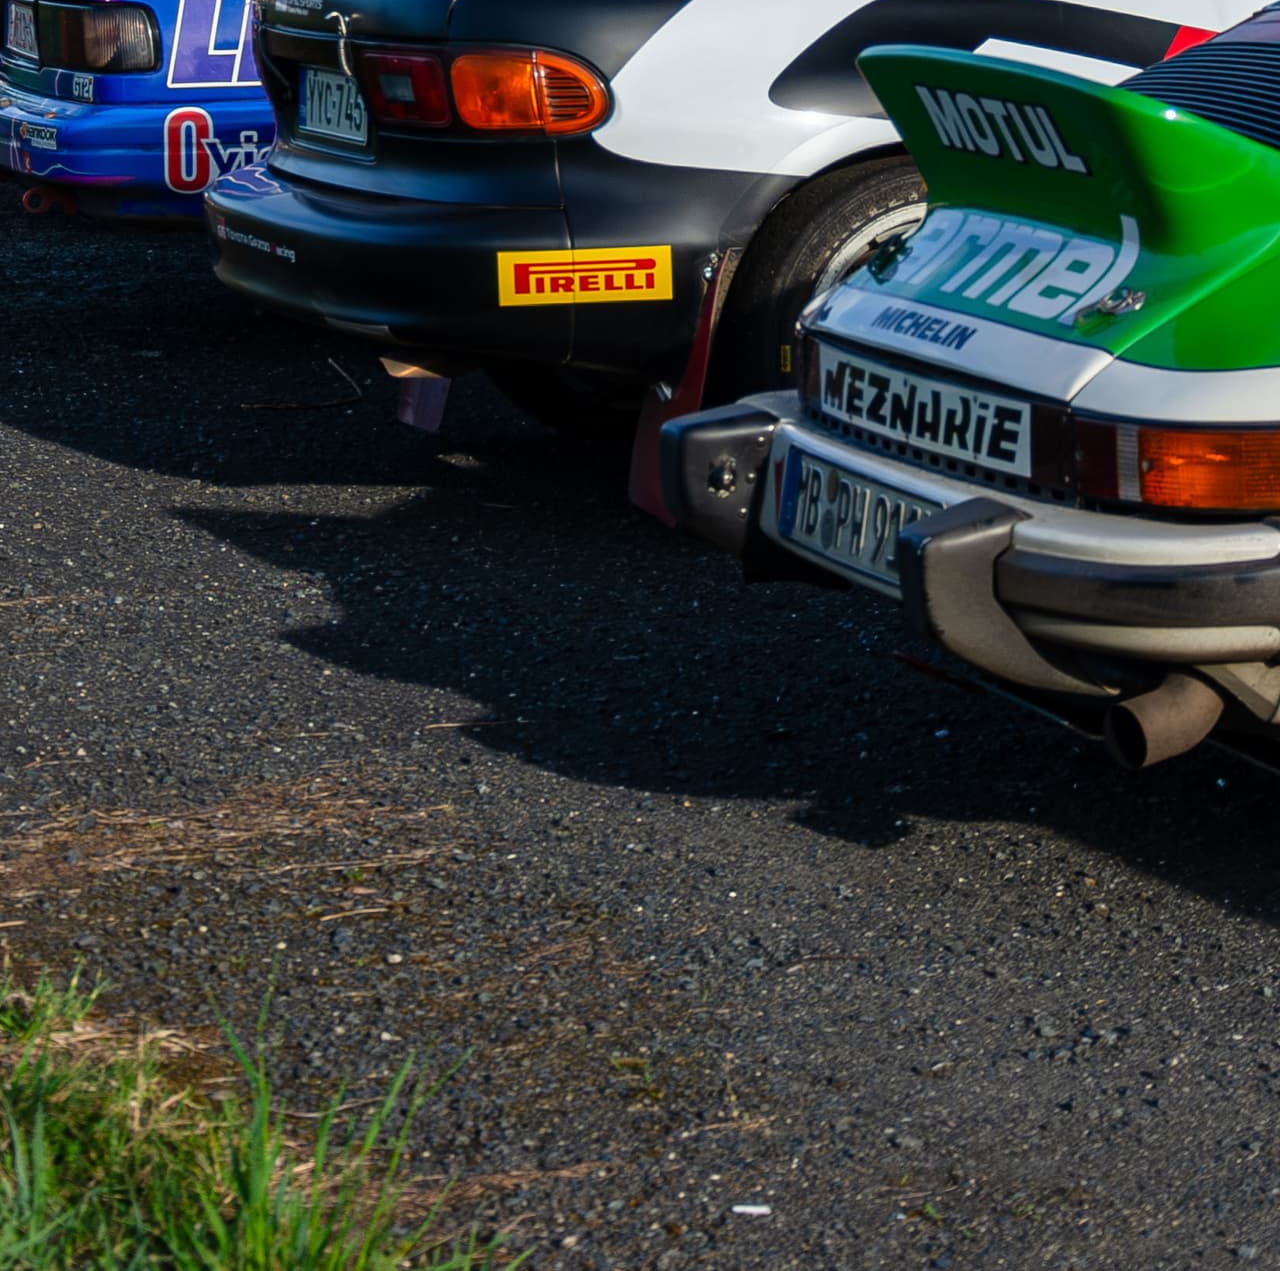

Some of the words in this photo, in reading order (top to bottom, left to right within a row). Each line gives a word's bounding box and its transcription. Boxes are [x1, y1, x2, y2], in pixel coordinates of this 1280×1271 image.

[914, 84, 1088, 175] MOTUL
[513, 258, 657, 295] PIRELLI
[871, 306, 978, 351] MICHELIN
